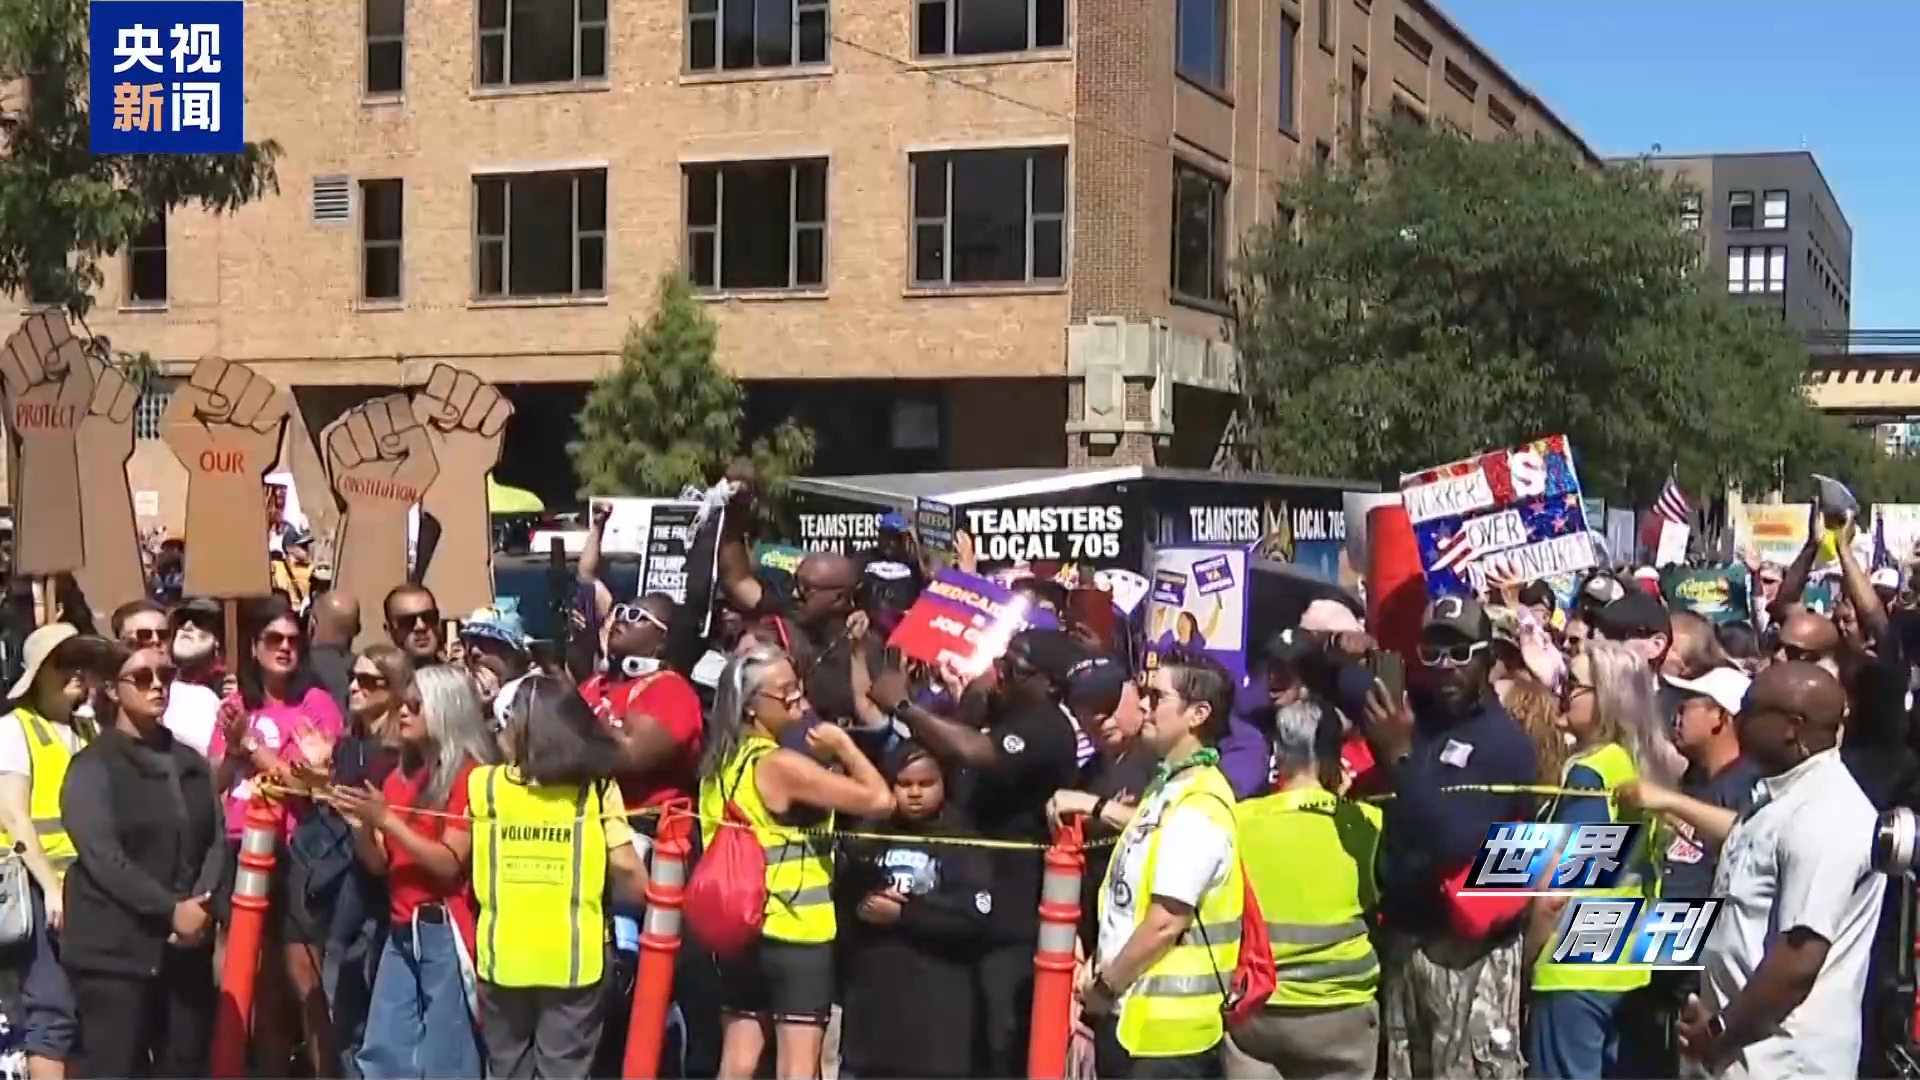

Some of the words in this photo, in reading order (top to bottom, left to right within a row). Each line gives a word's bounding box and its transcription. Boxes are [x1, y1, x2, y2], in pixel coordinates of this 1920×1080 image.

[16, 403, 75, 429] PROTECT
[200, 451, 245, 474] OUR
[966, 506, 1124, 534] TEAMSTERS
[1189, 506, 1260, 541] TEAMSTERS
[1293, 508, 1326, 540] LOCAL
[1328, 511, 1346, 541] 705
[1468, 512, 1521, 550] OVER
[976, 534, 1061, 562] LOCAL
[1067, 533, 1121, 559] 705
[649, 555, 687, 573] TRUMP
[501, 825, 572, 843] VOLUNTEER
